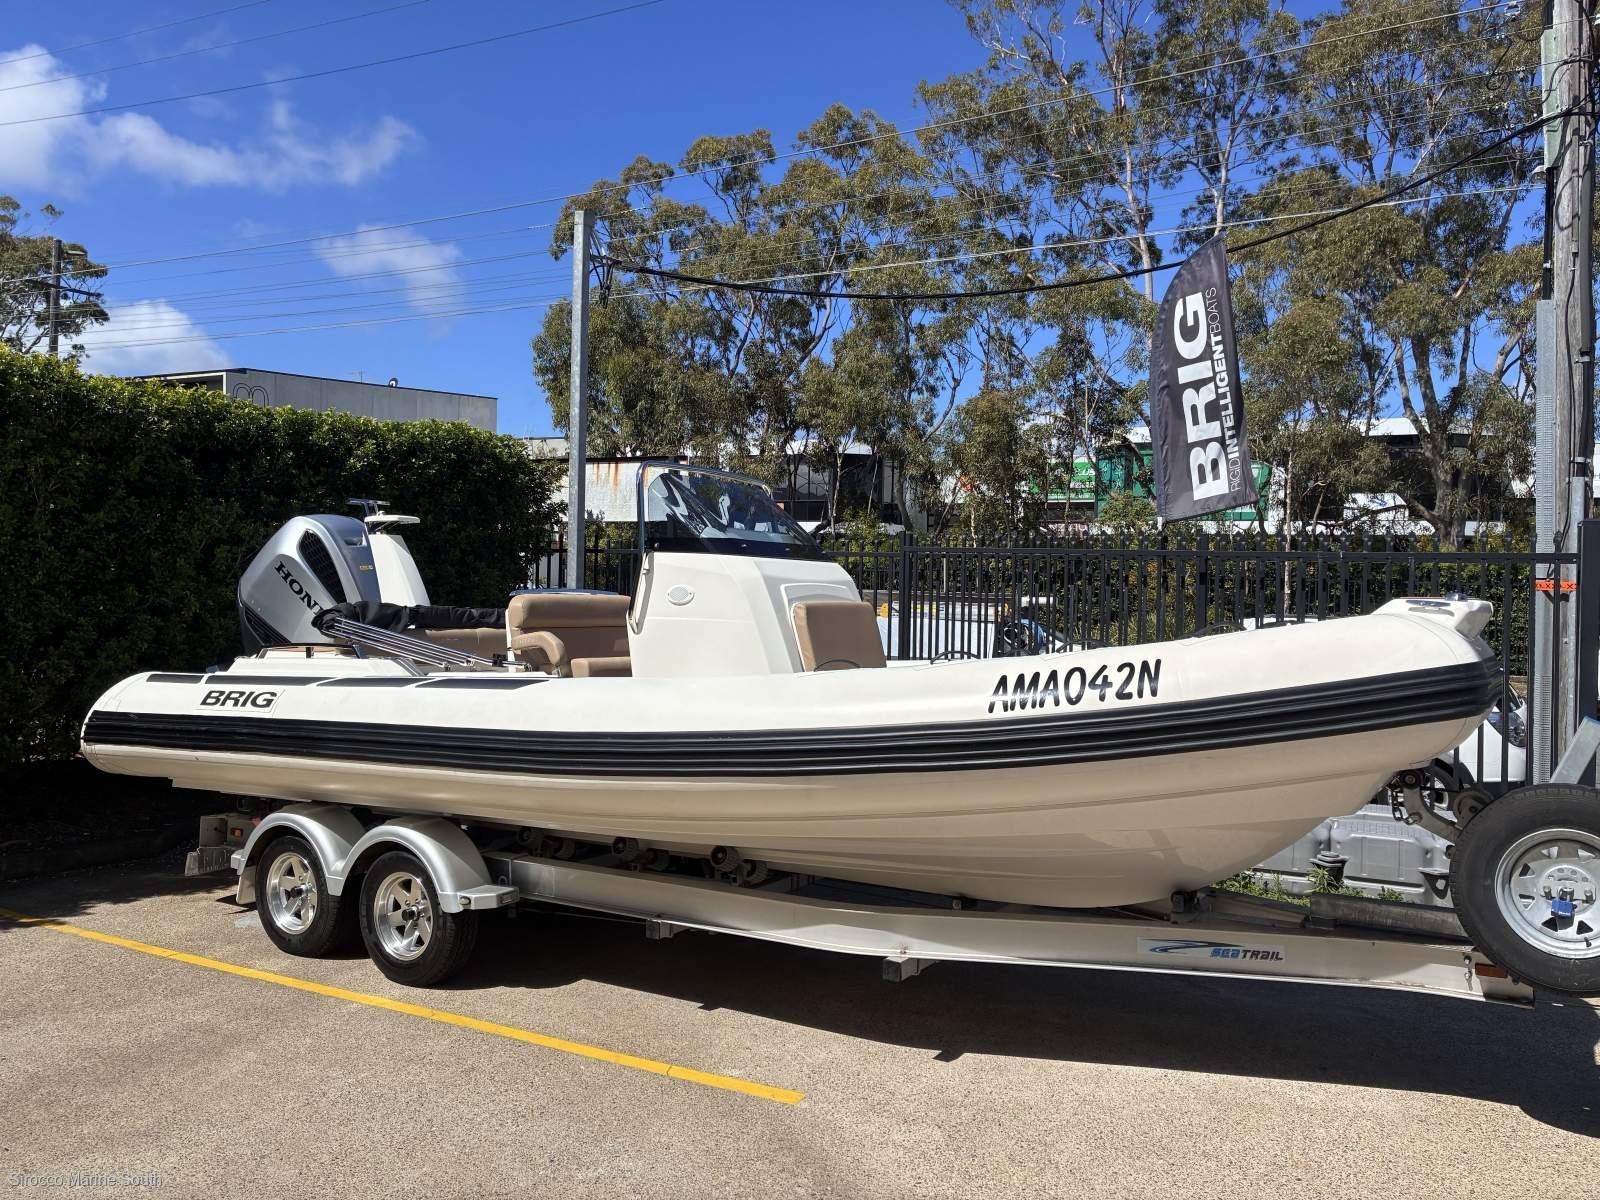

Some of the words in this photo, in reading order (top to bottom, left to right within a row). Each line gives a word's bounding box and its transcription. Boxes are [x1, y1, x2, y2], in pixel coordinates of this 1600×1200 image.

[1174, 292, 1229, 500] BRIG
[274, 561, 324, 616] HON
[200, 690, 277, 708] BRIG
[988, 659, 1161, 713] AMA042N
